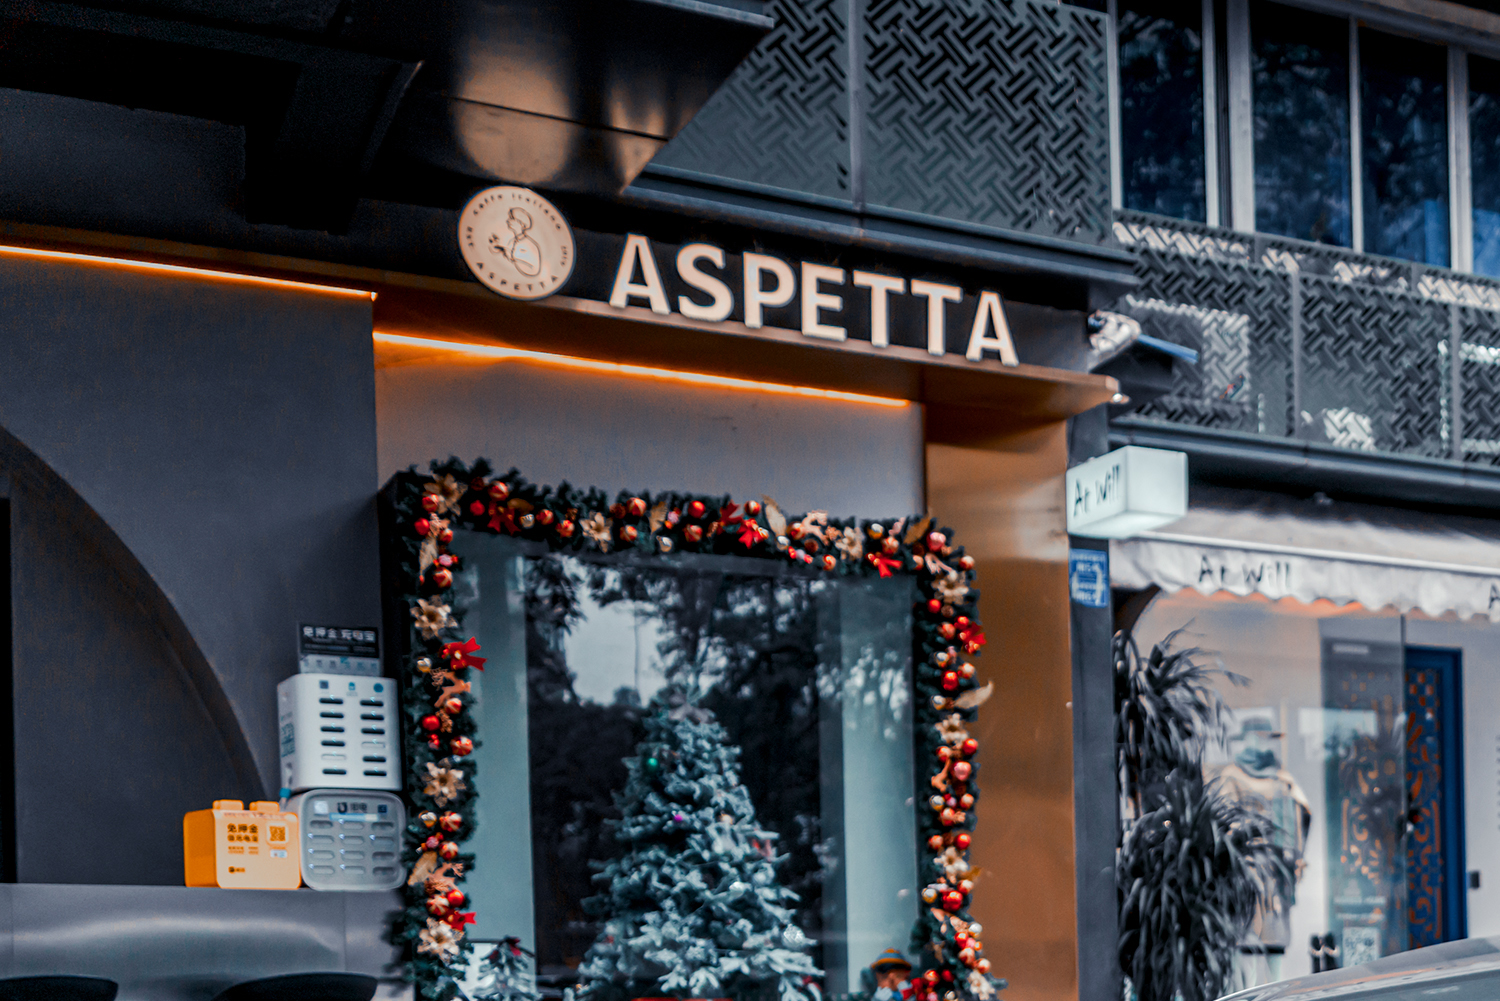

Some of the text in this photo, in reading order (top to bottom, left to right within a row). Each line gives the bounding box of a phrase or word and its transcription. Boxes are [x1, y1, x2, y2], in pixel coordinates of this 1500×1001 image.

[477, 261, 559, 292] ASPETTA
[608, 232, 1019, 367] ASPETTA
[1094, 463, 1121, 506] Will
[1242, 561, 1291, 589] Will
